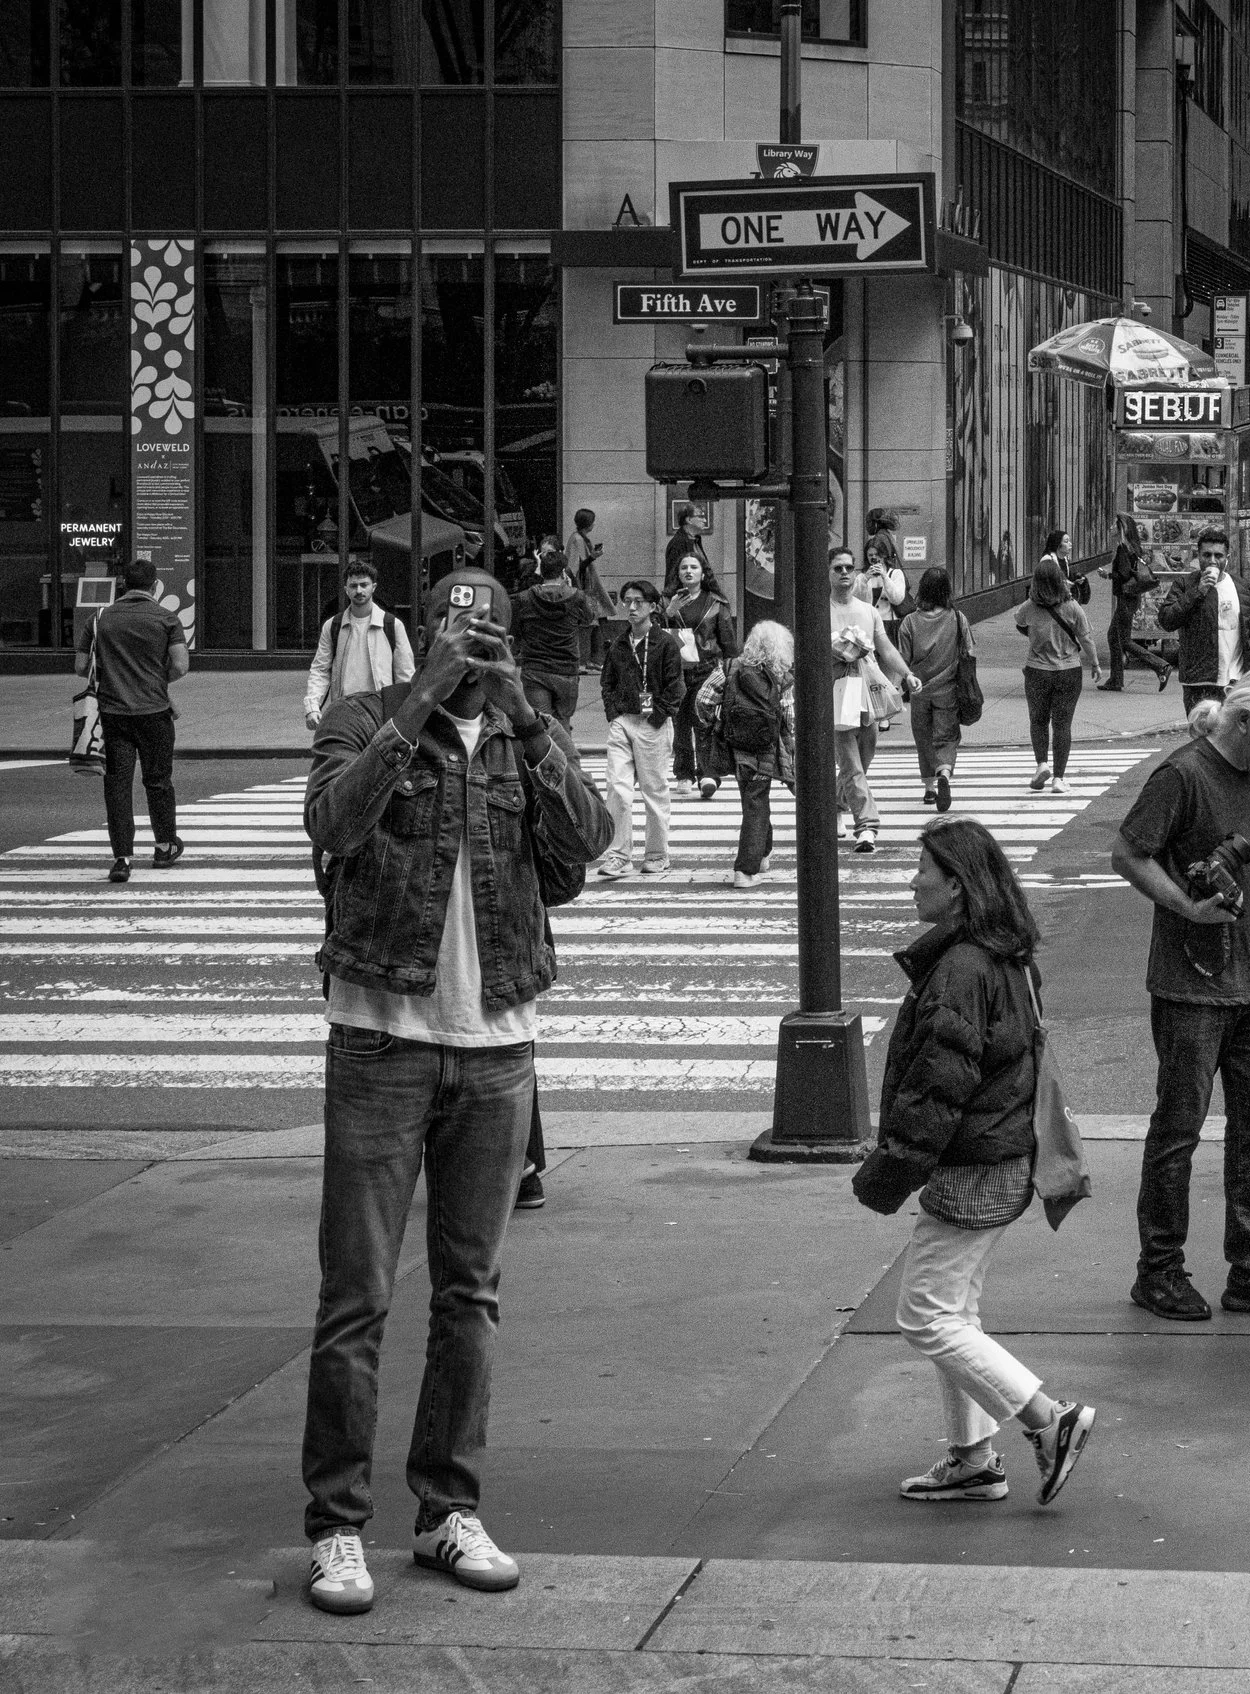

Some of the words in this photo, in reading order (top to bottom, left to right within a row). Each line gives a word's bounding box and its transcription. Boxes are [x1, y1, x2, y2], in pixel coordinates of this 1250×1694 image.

[763, 149, 792, 160] Library
[794, 150, 813, 160] Way
[720, 215, 785, 245] ONE
[815, 210, 886, 242] WAY
[640, 293, 691, 313] Fifth
[696, 293, 737, 313] Ave
[1217, 338, 1223, 349] 3
[136, 443, 190, 452] LOVEWELD
[60, 523, 123, 533] PERMANENT
[69, 537, 115, 547] JEWELRY
